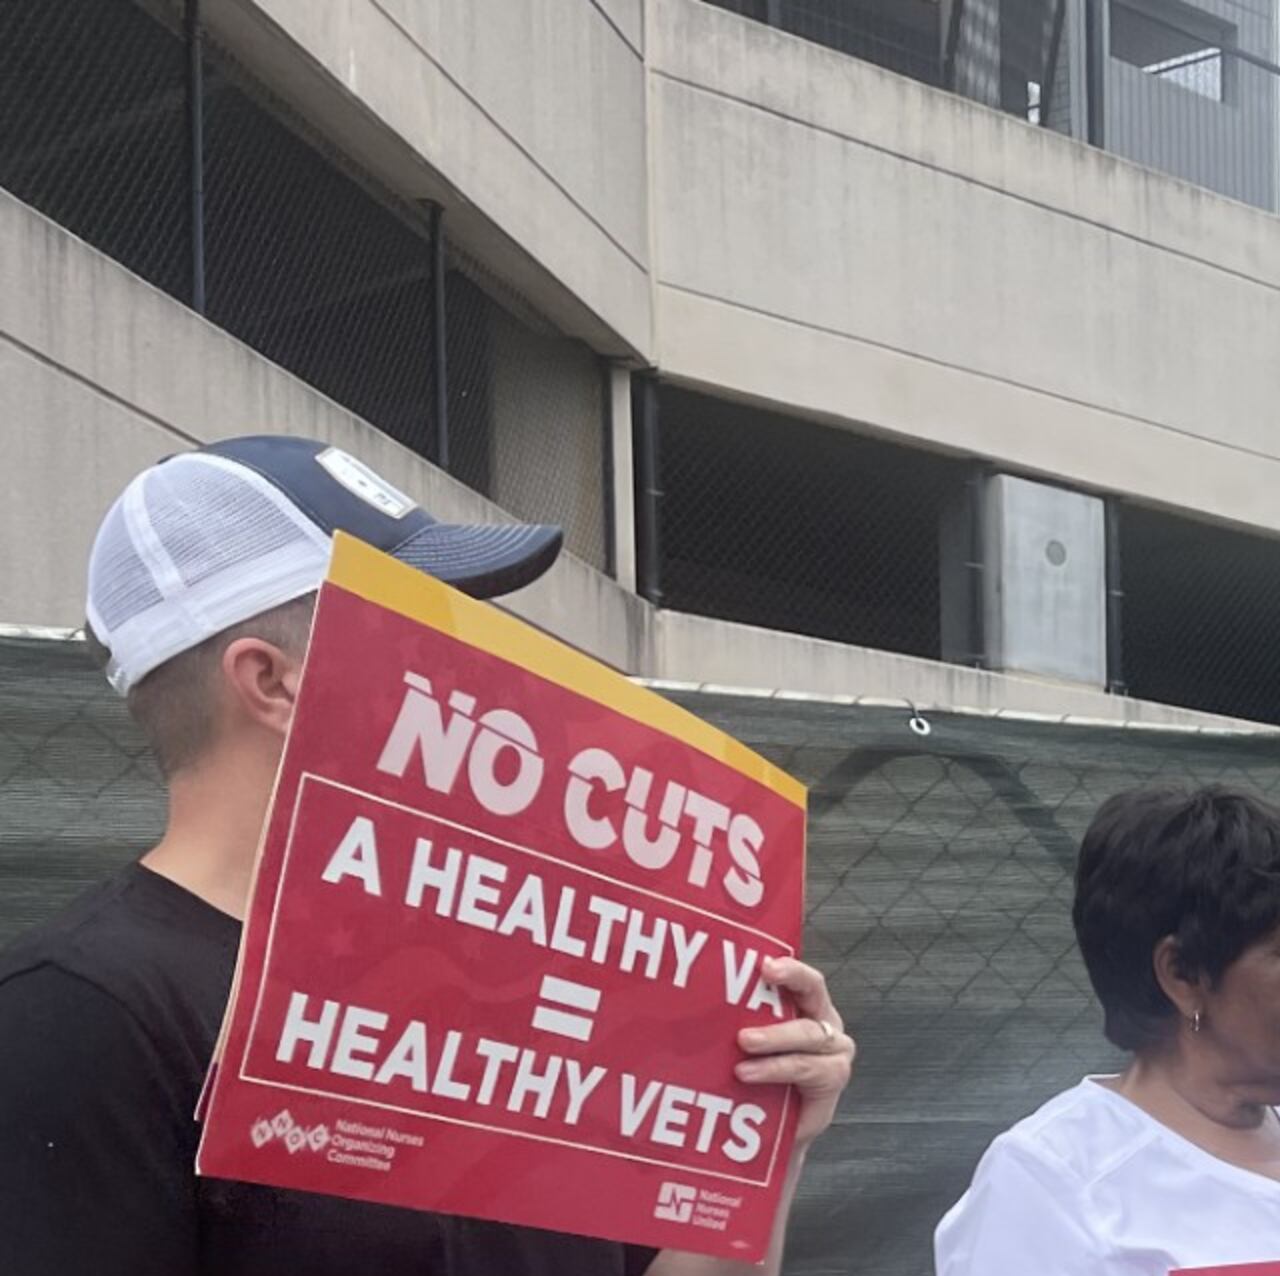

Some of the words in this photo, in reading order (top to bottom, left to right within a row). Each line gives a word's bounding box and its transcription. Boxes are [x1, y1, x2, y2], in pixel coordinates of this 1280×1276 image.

[376, 670, 545, 816] NO
[564, 747, 764, 907] CUTS
[321, 815, 382, 896] A
[404, 837, 709, 989] HEALTHY
[722, 939, 784, 1018] VA
[275, 991, 607, 1125] HEALTHY
[619, 1073, 767, 1163] VETS
[330, 1134, 396, 1159] Organizing
[336, 1119, 384, 1139] National
[385, 1128, 425, 1148] Nurses
